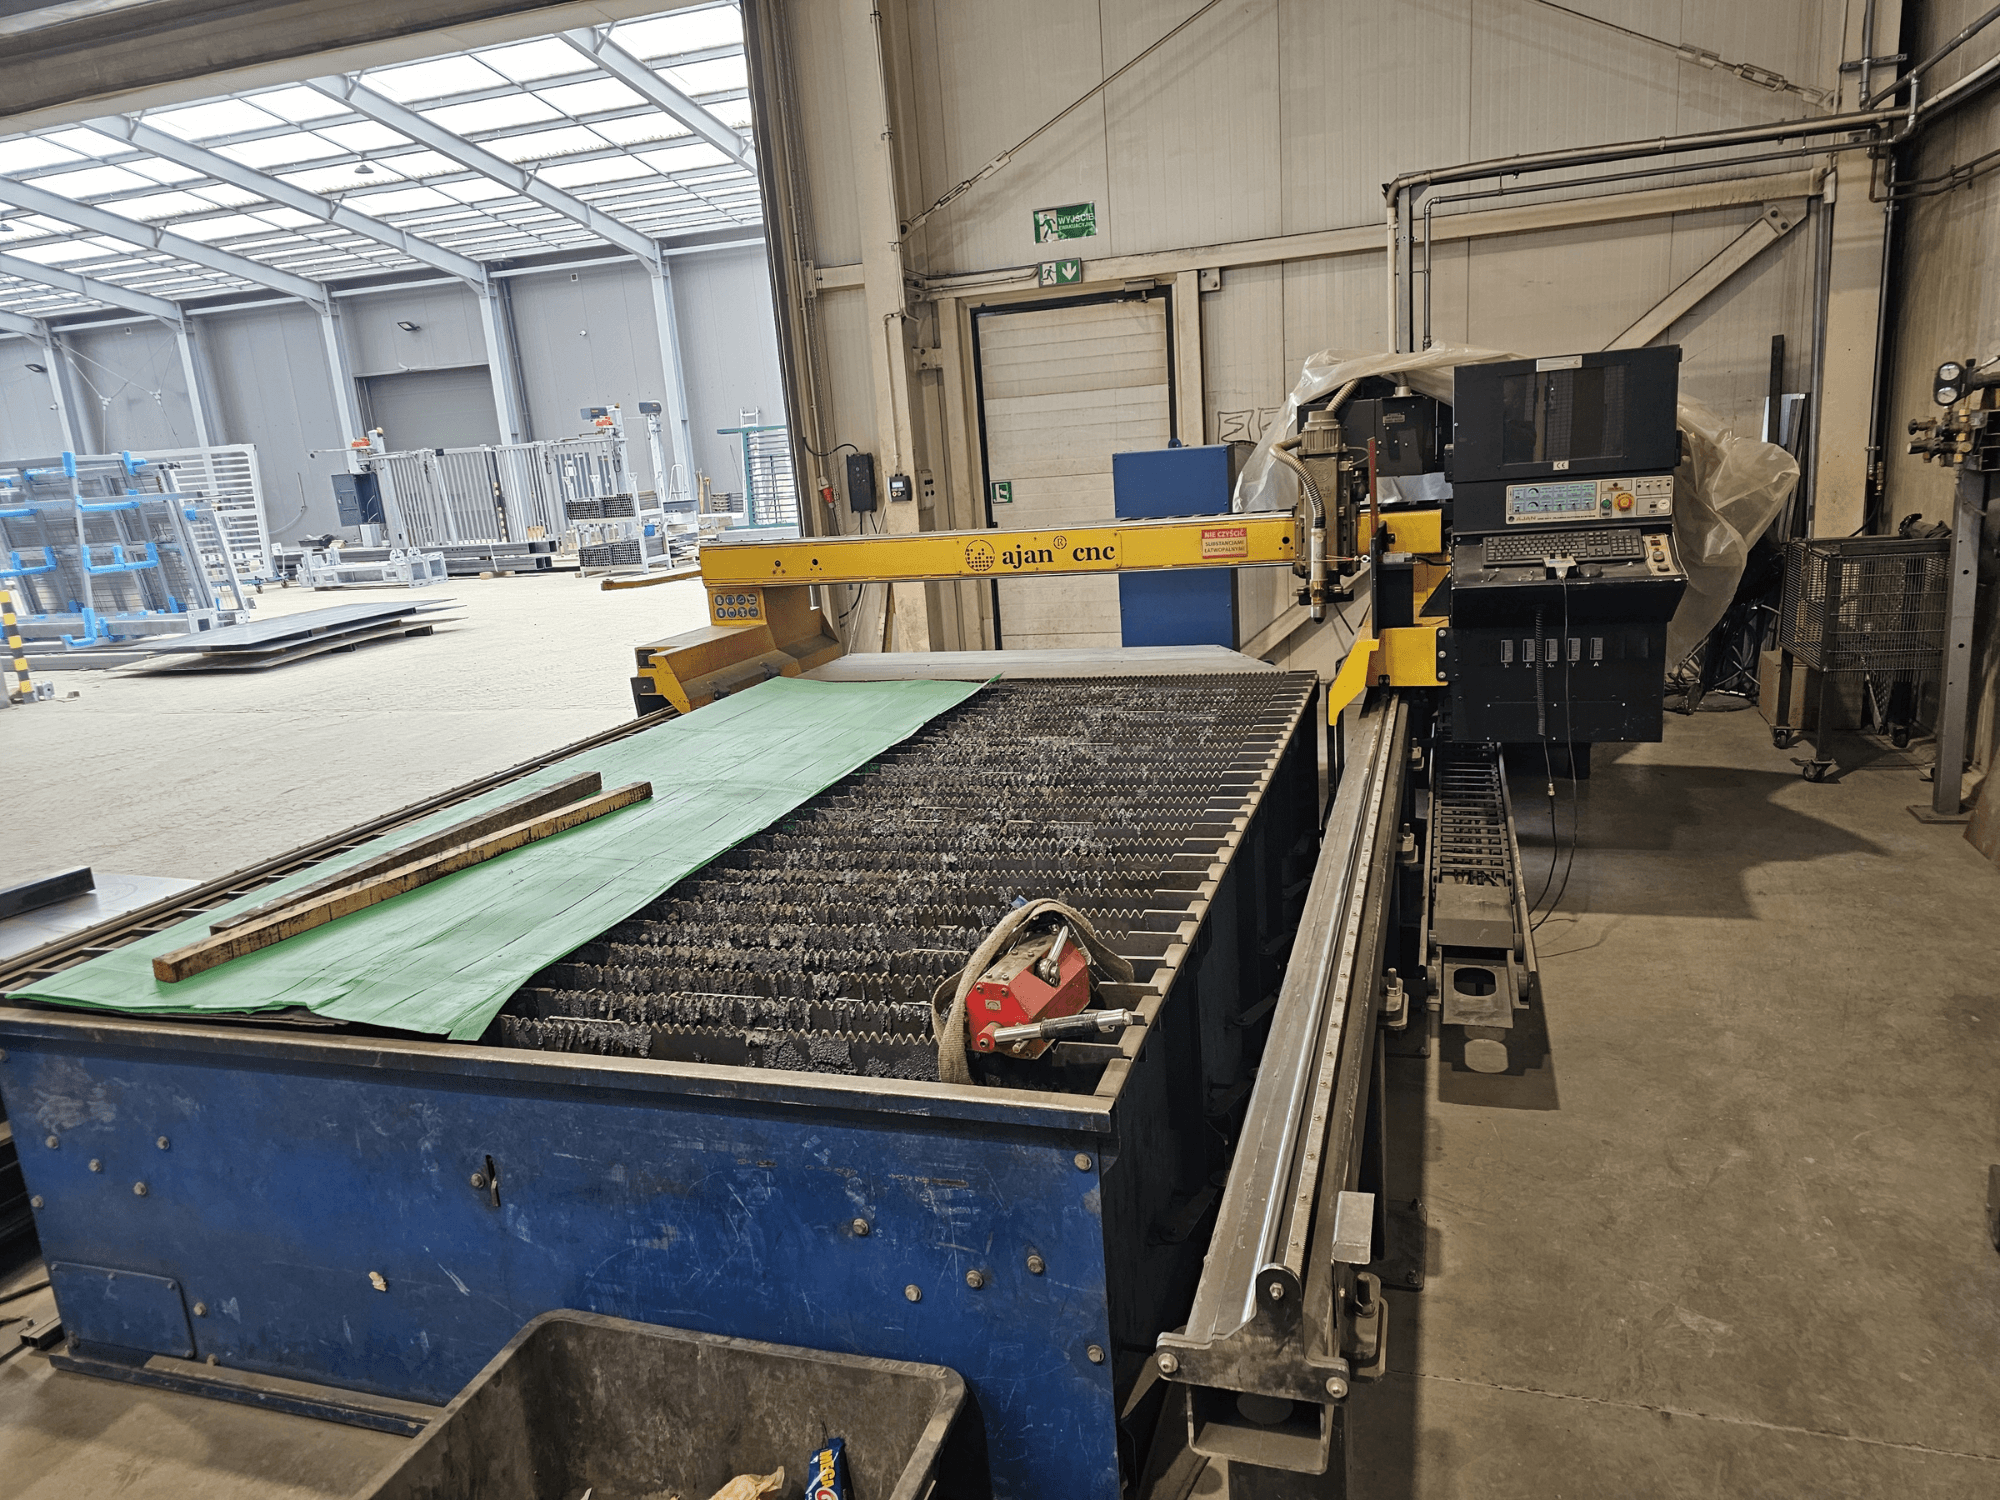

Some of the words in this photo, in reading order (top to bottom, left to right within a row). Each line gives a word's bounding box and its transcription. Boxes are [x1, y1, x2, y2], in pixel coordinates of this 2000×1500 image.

[1002, 544, 1054, 569] ajan
[1072, 545, 1115, 562] cnc
[819, 1449, 835, 1488] MEGA
